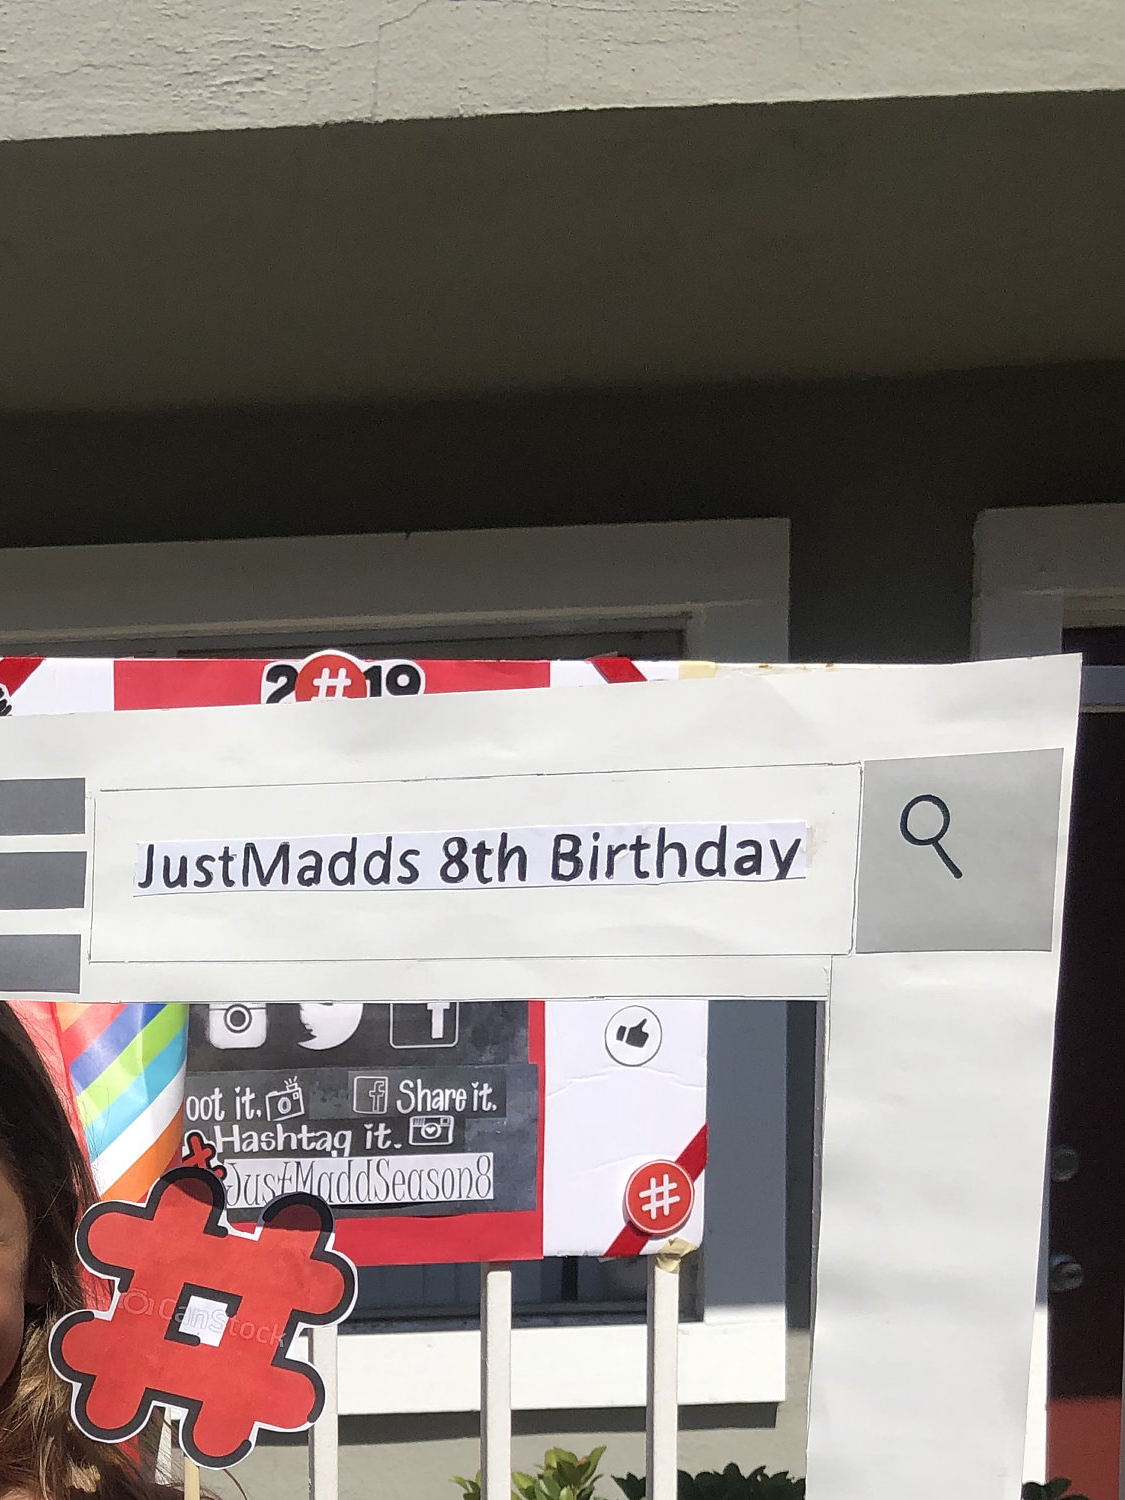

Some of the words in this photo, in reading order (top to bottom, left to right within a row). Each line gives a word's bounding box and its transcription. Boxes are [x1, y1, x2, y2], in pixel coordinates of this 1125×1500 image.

[137, 834, 420, 890] JustMadds
[440, 832, 527, 885] 8th
[551, 824, 805, 883] Birthday
[396, 1079, 467, 1114] Share
[214, 1124, 352, 1158] Hashtag
